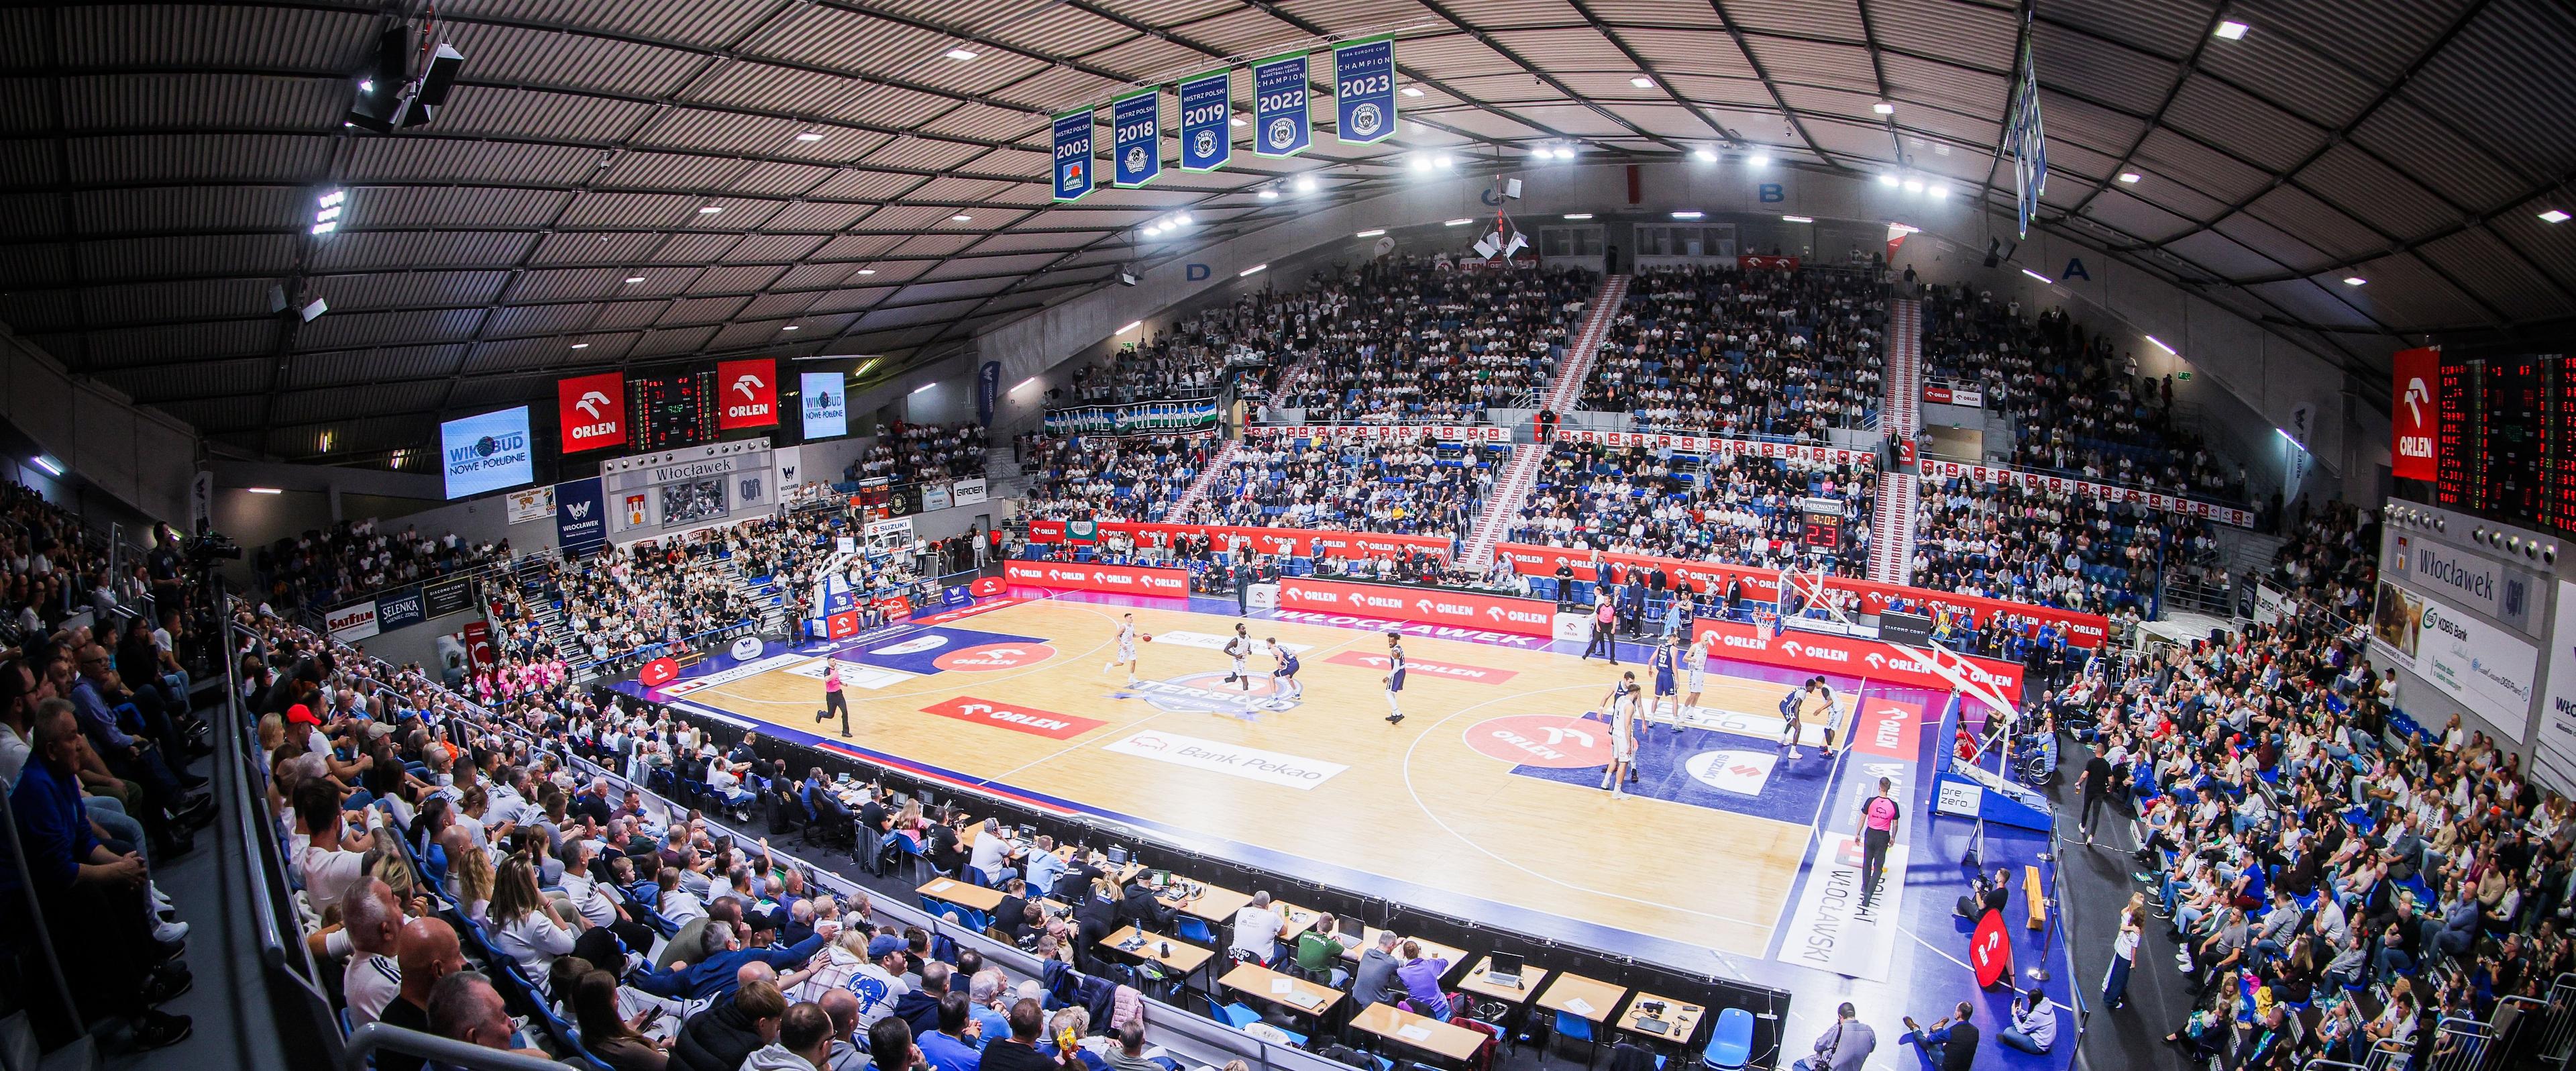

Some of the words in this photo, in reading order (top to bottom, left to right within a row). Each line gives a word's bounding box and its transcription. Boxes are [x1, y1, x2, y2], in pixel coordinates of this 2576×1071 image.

[1263, 66, 1283, 74] EUROPEAN
[1338, 56, 1390, 71] CHAMPION
[1257, 72, 1305, 88] CHAMPION
[1260, 70, 1285, 78] BASKETBALL
[1341, 74, 1390, 98] 2023
[1183, 93, 1204, 102] MISTRZ
[1205, 88, 1226, 98] POLSKI
[1260, 91, 1303, 113] 2022
[1116, 111, 1135, 120] MISTRZ
[1136, 105, 1155, 115] POLSKI
[1185, 103, 1224, 127] 2019
[1357, 107, 1376, 115] ANWIL
[1055, 127, 1073, 138] MISTRZ
[1073, 123, 1090, 132] POLSKI
[1273, 121, 1292, 130] ANWIL
[1118, 121, 1154, 144] 2018
[1197, 130, 1215, 140] ANWIL
[1057, 138, 1089, 160] 2003
[1065, 178, 1081, 187] ANWIL
[1759, 183, 1784, 202] B
[1186, 264, 1211, 281] D
[2061, 258, 2092, 280] A
[729, 403, 768, 417] ORLEN
[806, 411, 822, 419] NOWE
[1054, 407, 1112, 434] ANWIL
[1134, 402, 1203, 429] ULTRAS
[572, 421, 616, 439] ORLEN
[2400, 436, 2432, 458] ORLEN
[450, 462, 480, 476] NOWE
[484, 452, 526, 469] POŁUDNIE
[656, 459, 731, 481] Włocławek
[957, 486, 983, 497] GIRDER
[1806, 503, 1839, 511] AEROWATCH
[563, 519, 598, 532] WŁOCŁAWEK
[879, 521, 907, 531] SUZUKI
[1813, 515, 1837, 525] 9:02
[1273, 537, 1297, 546] OREN
[1807, 525, 1835, 546] 23
[1322, 540, 1346, 548] ORLEN
[1368, 542, 1394, 551] ORLEN
[1515, 554, 1543, 564] ORLEN
[1020, 569, 1042, 578] ORLEN
[1061, 571, 1085, 581] ORLEN
[1106, 574, 1132, 584] ORLEN
[2420, 548, 2494, 602] Włocławek
[1155, 578, 1182, 589] ORLEN
[1758, 579, 1778, 589] ORL
[429, 588, 450, 596] GIACOMO
[1304, 591, 1337, 602] ORLEN
[835, 595, 847, 606] TB
[1367, 596, 1403, 609] ORLEN
[382, 600, 419, 619] SELENKA
[829, 604, 853, 613] TERBUD
[1436, 603, 1473, 615] ORLEN
[386, 614, 404, 624] WIENIEC
[1508, 610, 1546, 624] ORLEN
[1270, 609, 1540, 646] WŁOCŁAWEK
[1805, 622, 1828, 630] JAWORSKI
[1884, 625, 1909, 633] GIACOMO
[1910, 627, 1926, 635] CONTI
[2074, 624, 2102, 636] ORLEN
[2437, 617, 2453, 635] KDBS
[2454, 625, 2468, 642] Bank
[1723, 635, 1767, 651] ORLEN
[1658, 653, 1667, 664] 37
[1805, 646, 1848, 662] ORLEN
[952, 657, 1018, 666] ORLEN
[655, 672, 669, 680] ORLEN
[1402, 662, 1487, 678] ORLEN
[1136, 679, 1295, 711] TERBUD
[989, 711, 1071, 731] ORLEN
[1875, 718, 1901, 750] ORLEN
[1491, 729, 1566, 760] ORLEN
[1176, 745, 1245, 766] Bank
[1248, 756, 1322, 780] Pekao
[1704, 753, 1730, 780] SUZUKI
[1941, 787, 1962, 799] pre
[1941, 797, 1968, 808] zero
[1803, 870, 1854, 962] WŁOCŁAWSKI
[1978, 944, 1989, 966] ORLEN
[2393, 1059, 2404, 1068] H2
